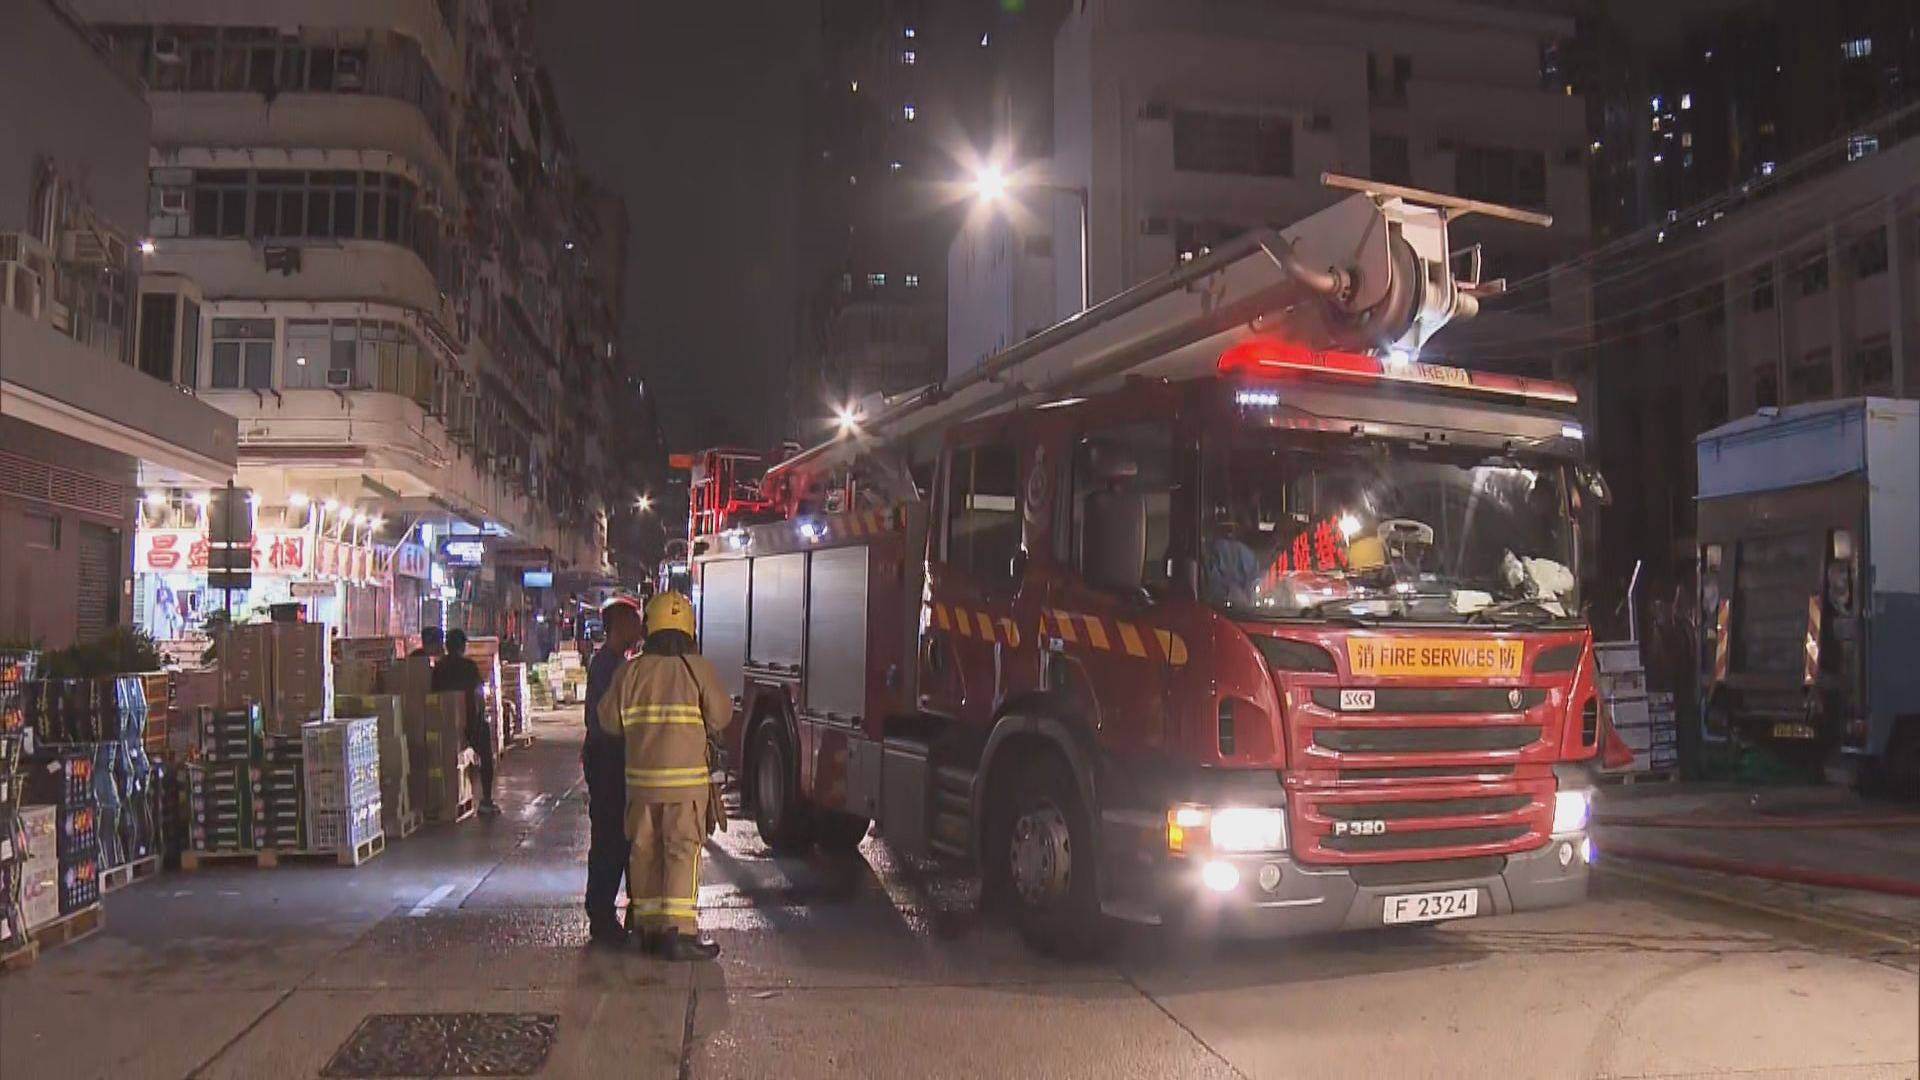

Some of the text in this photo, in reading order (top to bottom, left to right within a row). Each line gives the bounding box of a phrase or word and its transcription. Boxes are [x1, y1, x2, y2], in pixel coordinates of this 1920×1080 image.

[147, 532, 304, 571] 昌盛欄
[1381, 648, 1495, 667] FIRE SERVICES
[1336, 822, 1348, 836] P
[1395, 894, 1467, 919] F 2324
